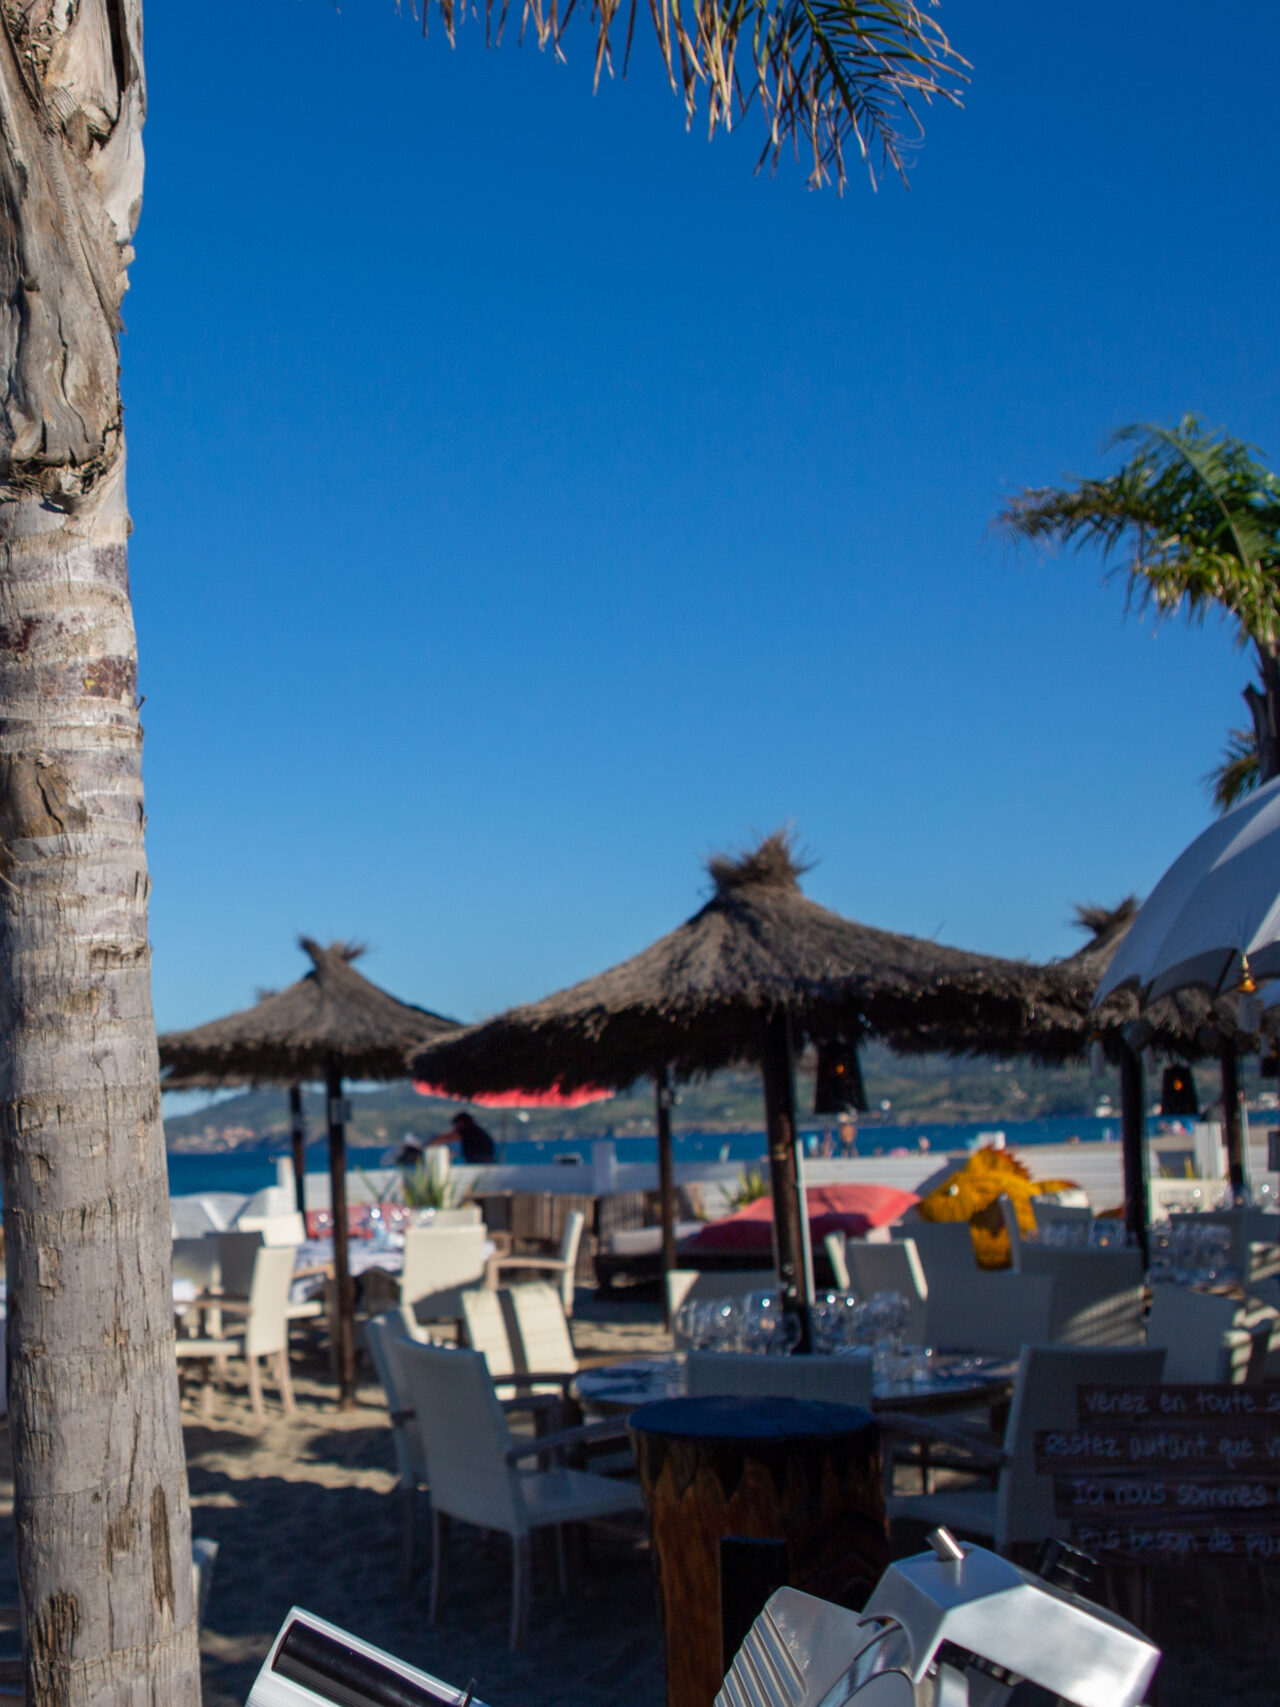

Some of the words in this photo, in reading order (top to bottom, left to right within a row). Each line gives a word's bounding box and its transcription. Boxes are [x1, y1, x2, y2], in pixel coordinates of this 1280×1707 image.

[1086, 1391, 1149, 1413] Venez
[1160, 1392, 1186, 1413] en
[1196, 1389, 1256, 1414] toute
[1219, 1436, 1254, 1469] que
[1114, 1483, 1166, 1505] nous
[1176, 1484, 1267, 1508] sommes
